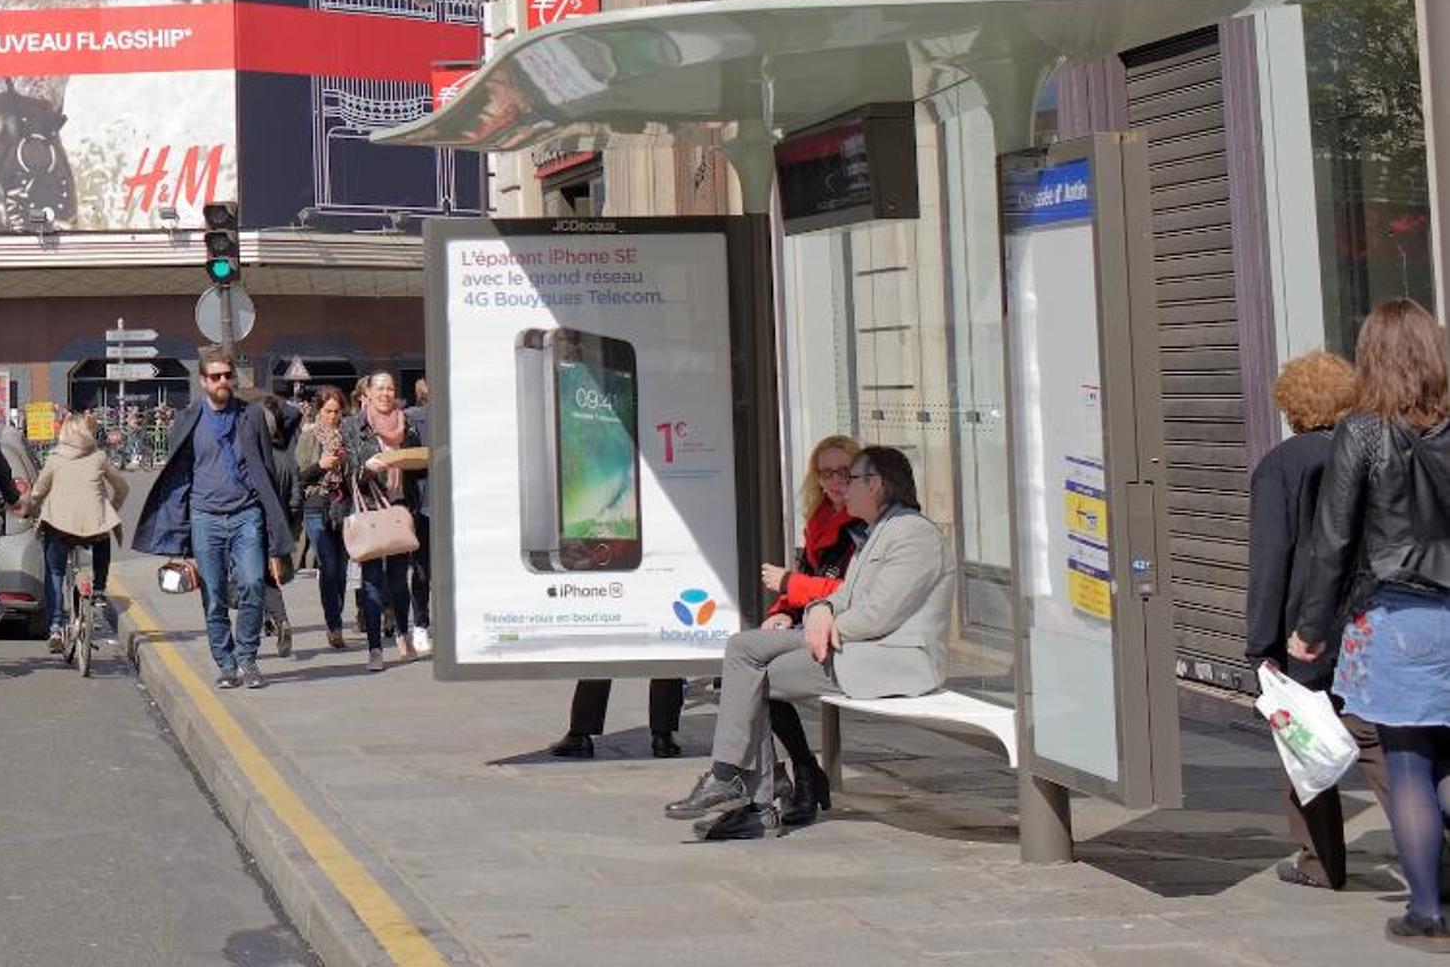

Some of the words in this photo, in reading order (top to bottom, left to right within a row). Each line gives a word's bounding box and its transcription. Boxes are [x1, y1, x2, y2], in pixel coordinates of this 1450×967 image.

[124, 144, 225, 213] H&M
[461, 249, 544, 270] L'épatant
[549, 248, 610, 265] iPhone
[615, 248, 638, 264] SE
[462, 274, 506, 287] avec
[508, 271, 523, 286] le
[529, 270, 581, 288] grand
[585, 270, 644, 285] réseau
[463, 292, 489, 307] 4G
[494, 292, 583, 310] Bouygues
[559, 583, 608, 599] iPhone
[483, 612, 553, 624] Rendez-vous
[556, 614, 569, 624] en
[572, 612, 622, 625] boutique
[660, 626, 730, 643] bouygues
